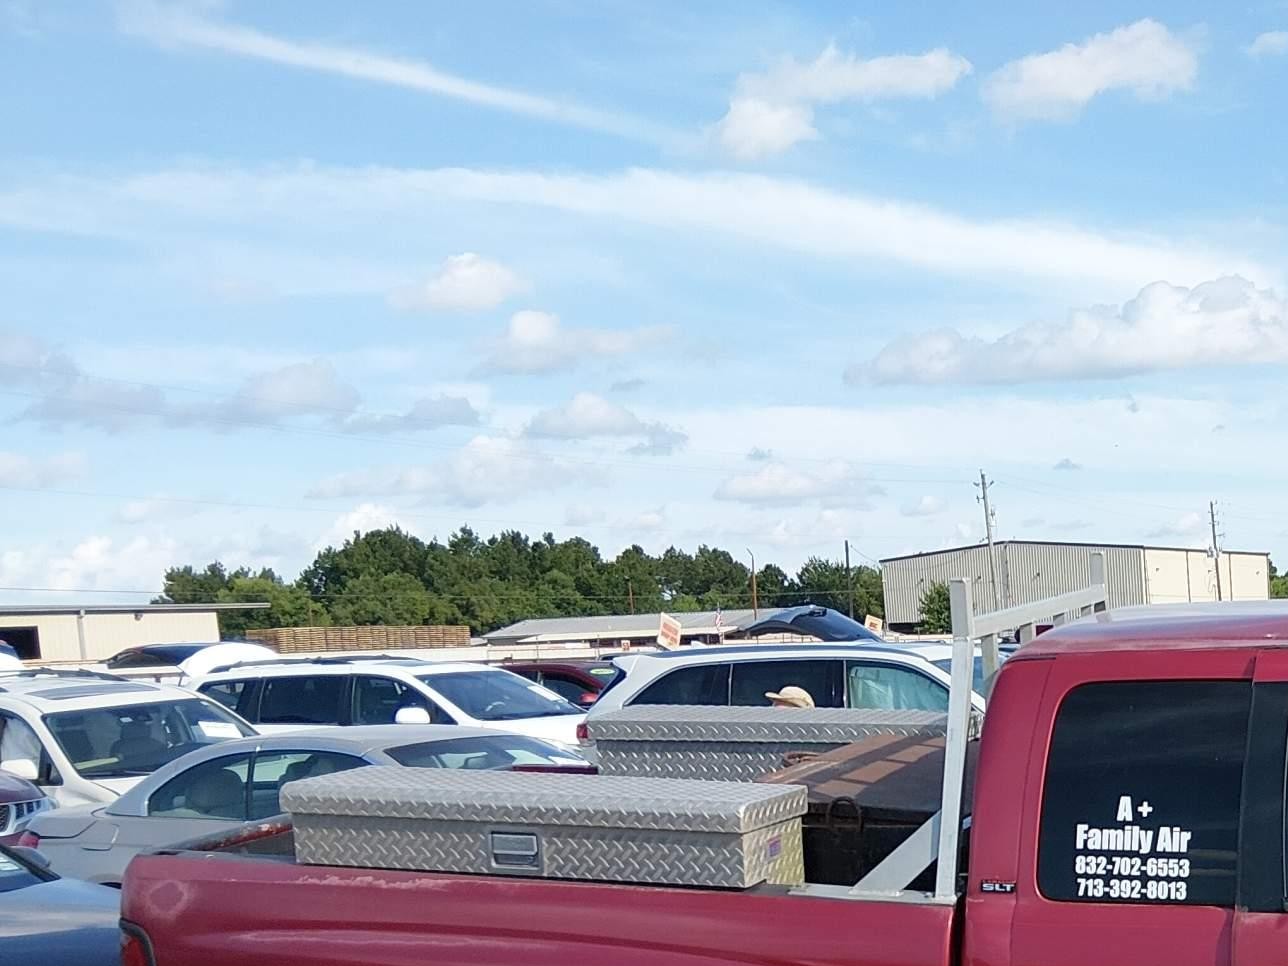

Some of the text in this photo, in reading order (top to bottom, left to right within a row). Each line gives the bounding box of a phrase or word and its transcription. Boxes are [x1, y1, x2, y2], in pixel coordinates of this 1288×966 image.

[1116, 795, 1133, 822] A
[1075, 823, 1192, 854] Family Air
[1075, 855, 1190, 878] 832-702-6553
[982, 883, 1015, 892] SLT
[1077, 878, 1187, 900] 713-392-8013
